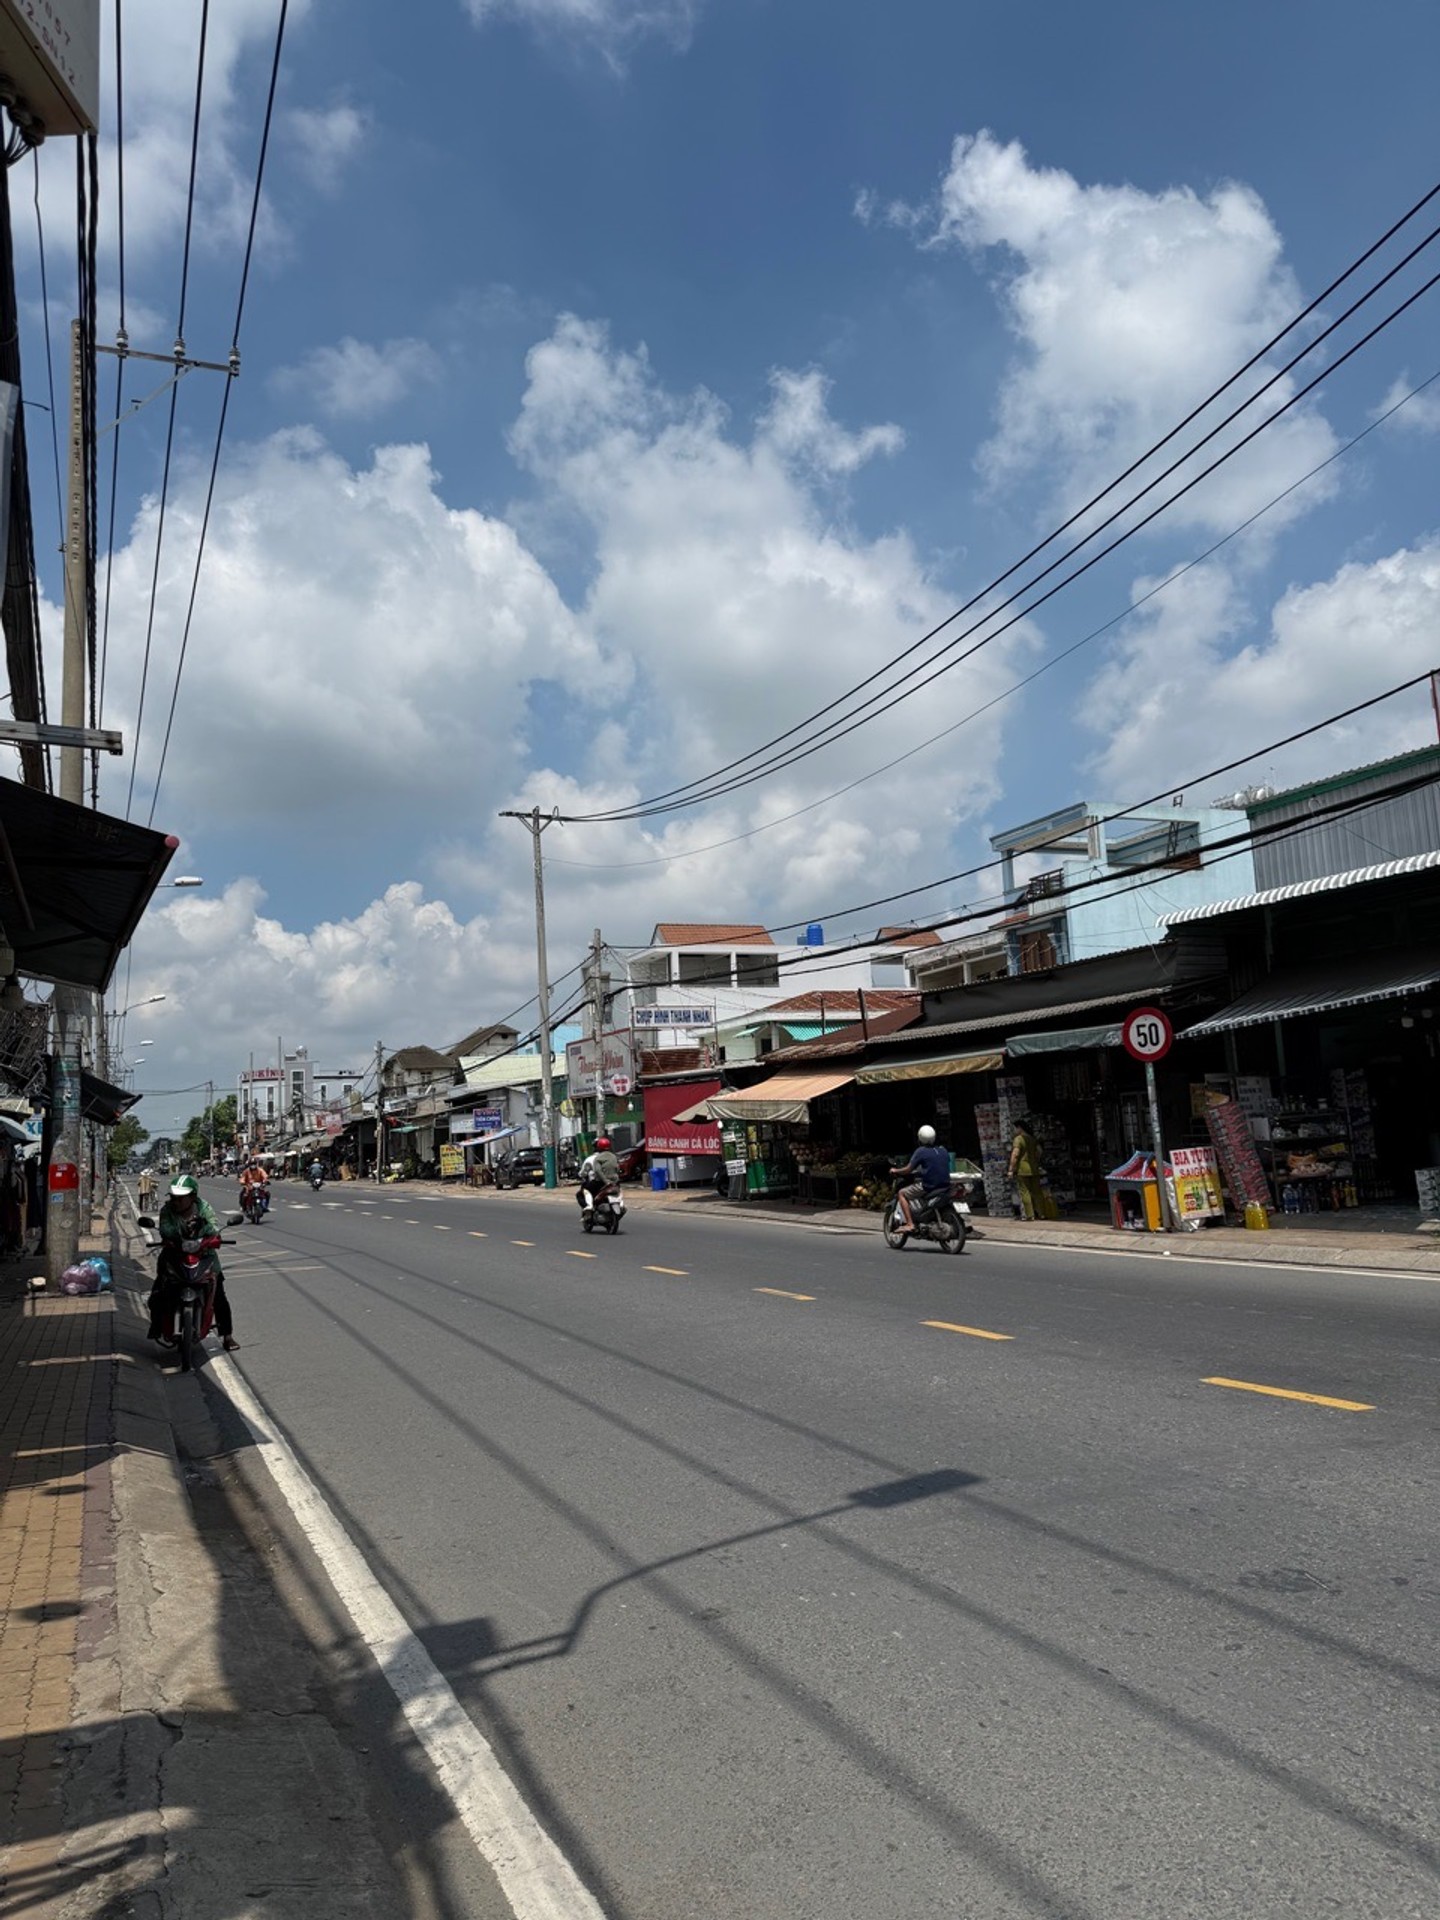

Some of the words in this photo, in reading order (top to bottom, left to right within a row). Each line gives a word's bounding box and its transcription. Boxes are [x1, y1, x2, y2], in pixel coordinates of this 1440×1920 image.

[1136, 1022, 1160, 1049] 50
[648, 1135, 668, 1148] BÁNH
[669, 1138, 690, 1149] CANH
[704, 1135, 720, 1149] LÓC
[1173, 1151, 1190, 1166] BIA
